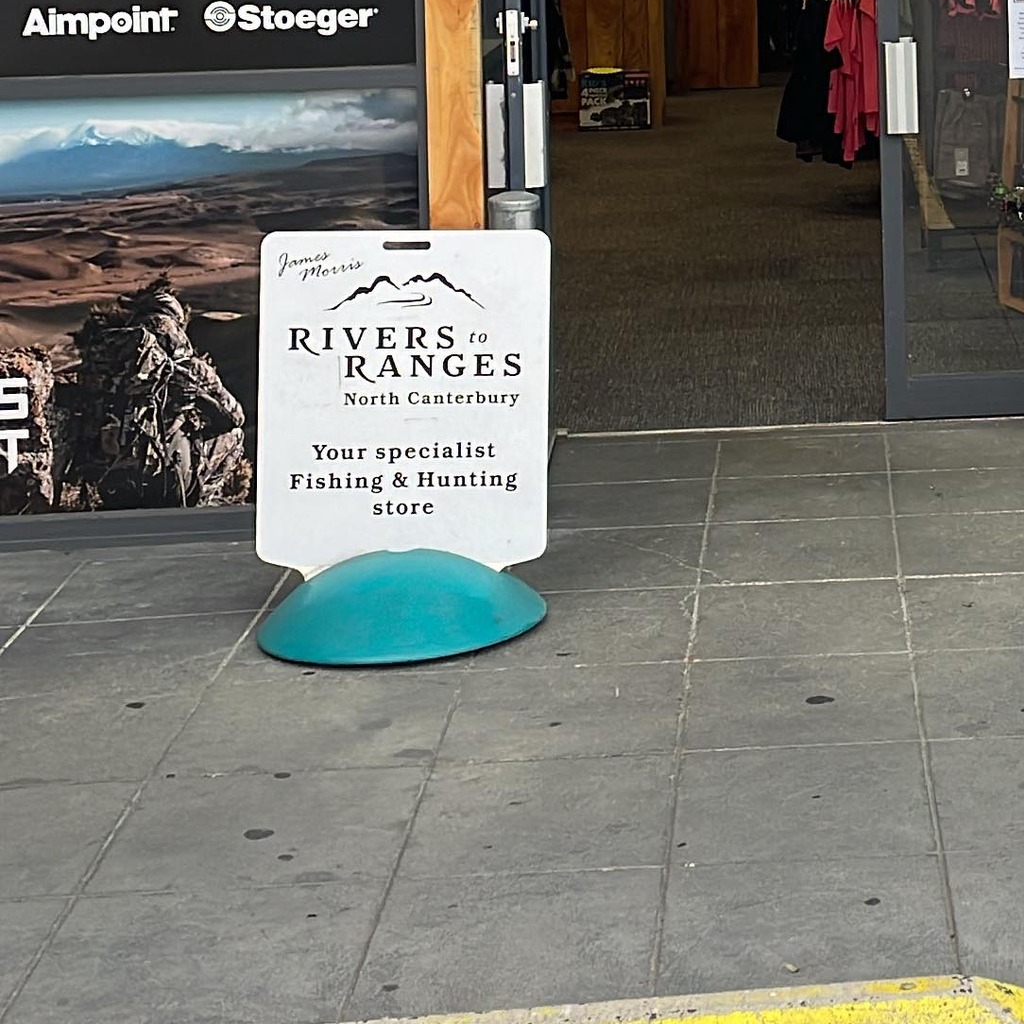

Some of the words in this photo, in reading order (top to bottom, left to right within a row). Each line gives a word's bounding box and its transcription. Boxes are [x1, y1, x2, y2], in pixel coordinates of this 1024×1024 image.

[22, 5, 179, 40] Aimpoint
[237, 4, 375, 35] Stoeger
[278, 251, 330, 277] James
[299, 257, 364, 282] Morris
[288, 326, 455, 356] RIVERS
[469, 330, 487, 344] to
[344, 353, 522, 384] RANGES
[344, 392, 400, 406] North
[407, 391, 520, 407] Canterbury
[312, 444, 368, 461] Your
[375, 442, 496, 463] specialist
[290, 472, 384, 493] Fishing
[392, 472, 408, 489] &
[418, 471, 518, 491] Hunting
[372, 500, 434, 516] store
